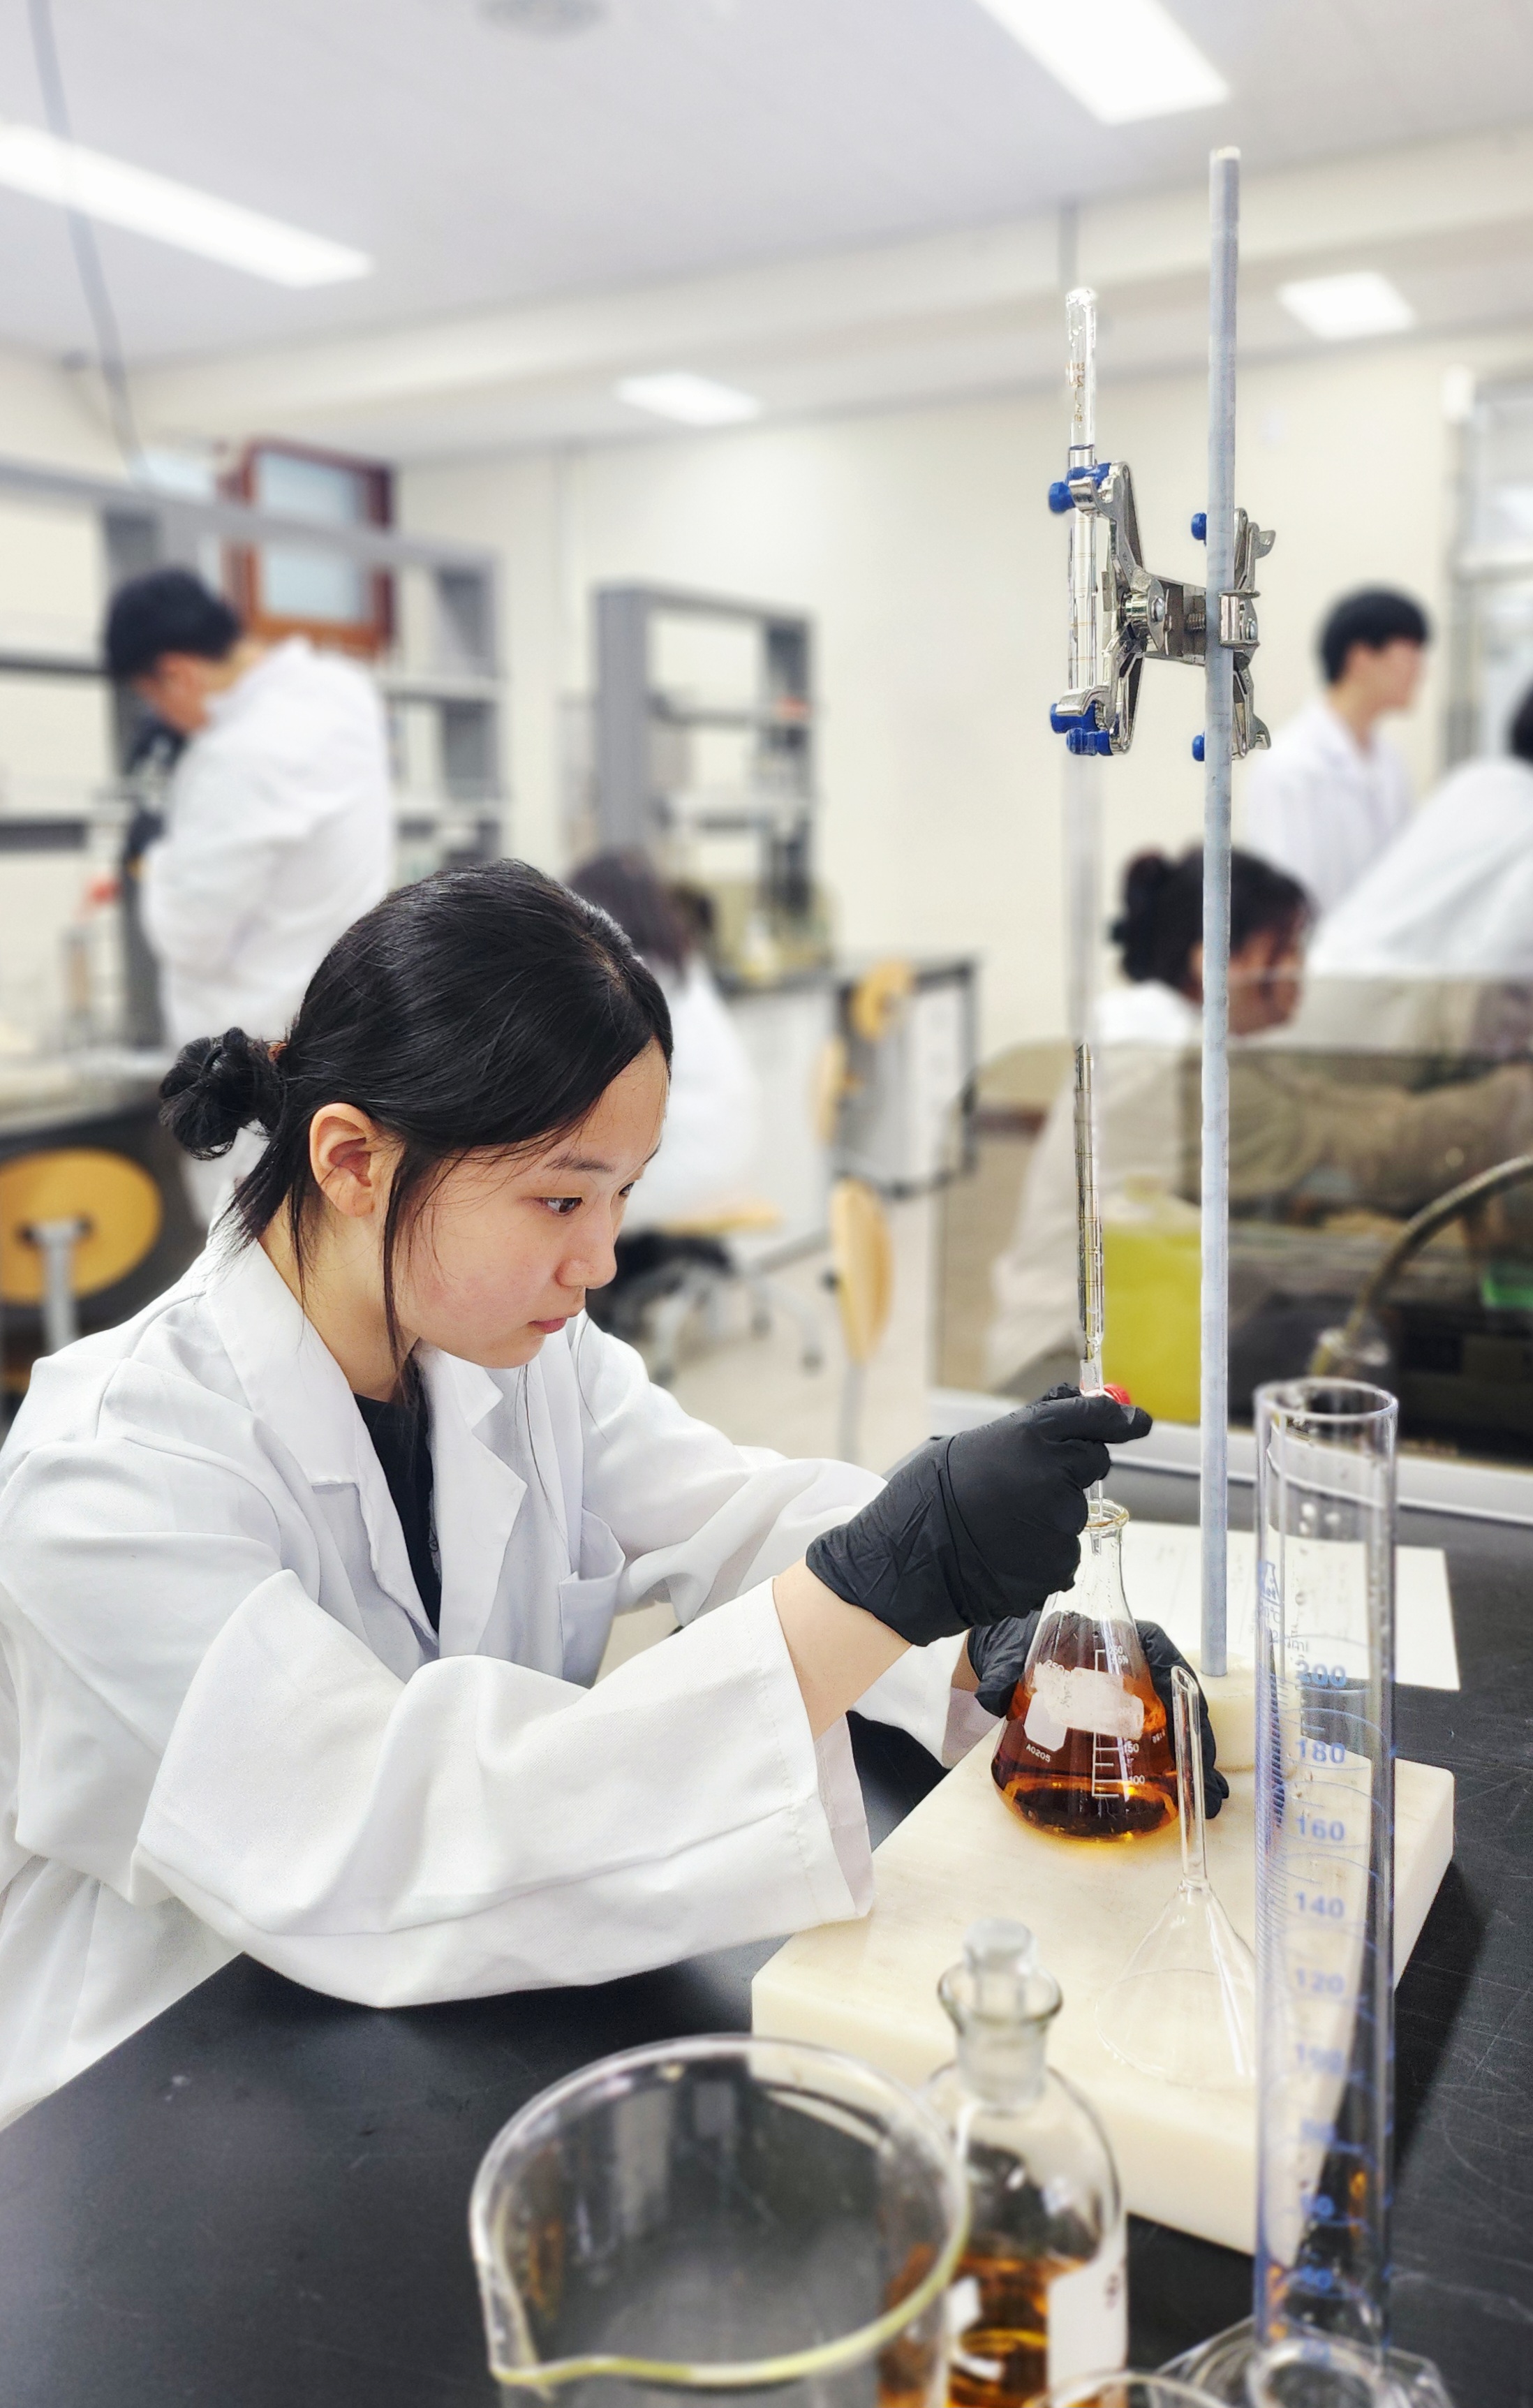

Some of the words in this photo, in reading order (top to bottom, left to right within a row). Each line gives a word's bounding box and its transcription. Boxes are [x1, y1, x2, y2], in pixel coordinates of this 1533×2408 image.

[1294, 1659, 1347, 1688] 200
[1123, 1743, 1139, 1753] 150
[1296, 1737, 1346, 1764] 180
[1129, 1775, 1145, 1785] 100
[1296, 1815, 1345, 1841] 160
[1296, 1891, 1345, 1919] 140
